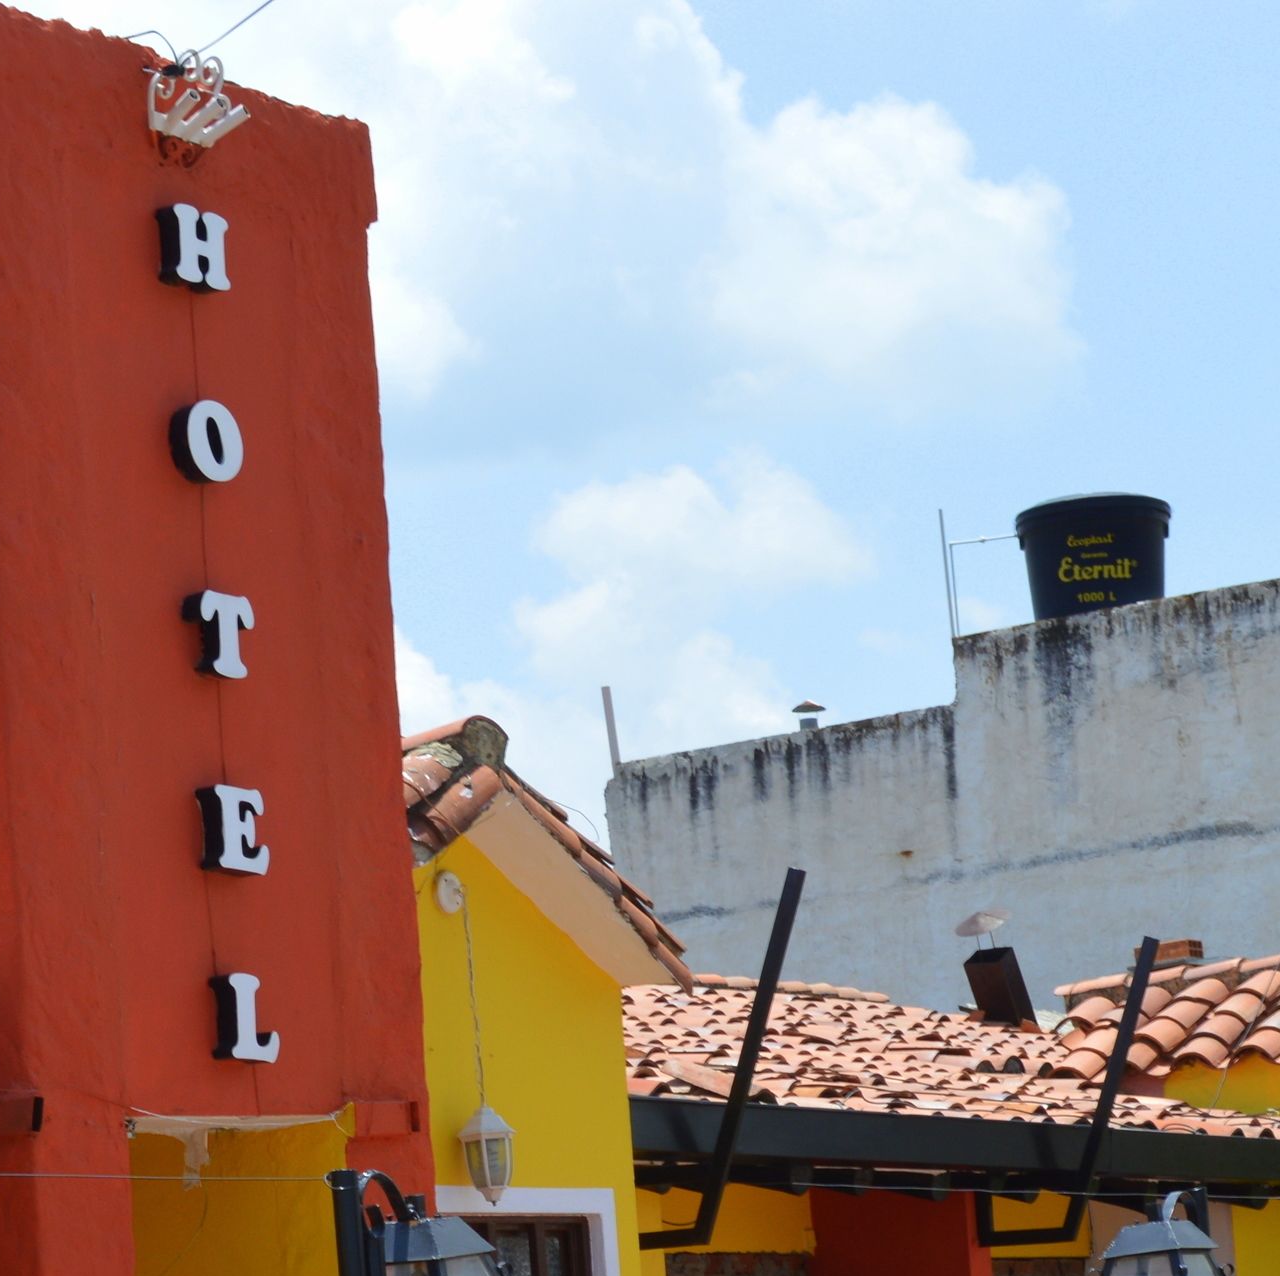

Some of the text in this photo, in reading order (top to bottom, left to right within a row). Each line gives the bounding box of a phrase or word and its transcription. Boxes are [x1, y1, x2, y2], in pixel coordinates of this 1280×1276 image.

[1058, 556, 1132, 582] Eternit
[1077, 590, 1117, 603] 1000 L
[156, 202, 280, 1064] HOTEL
